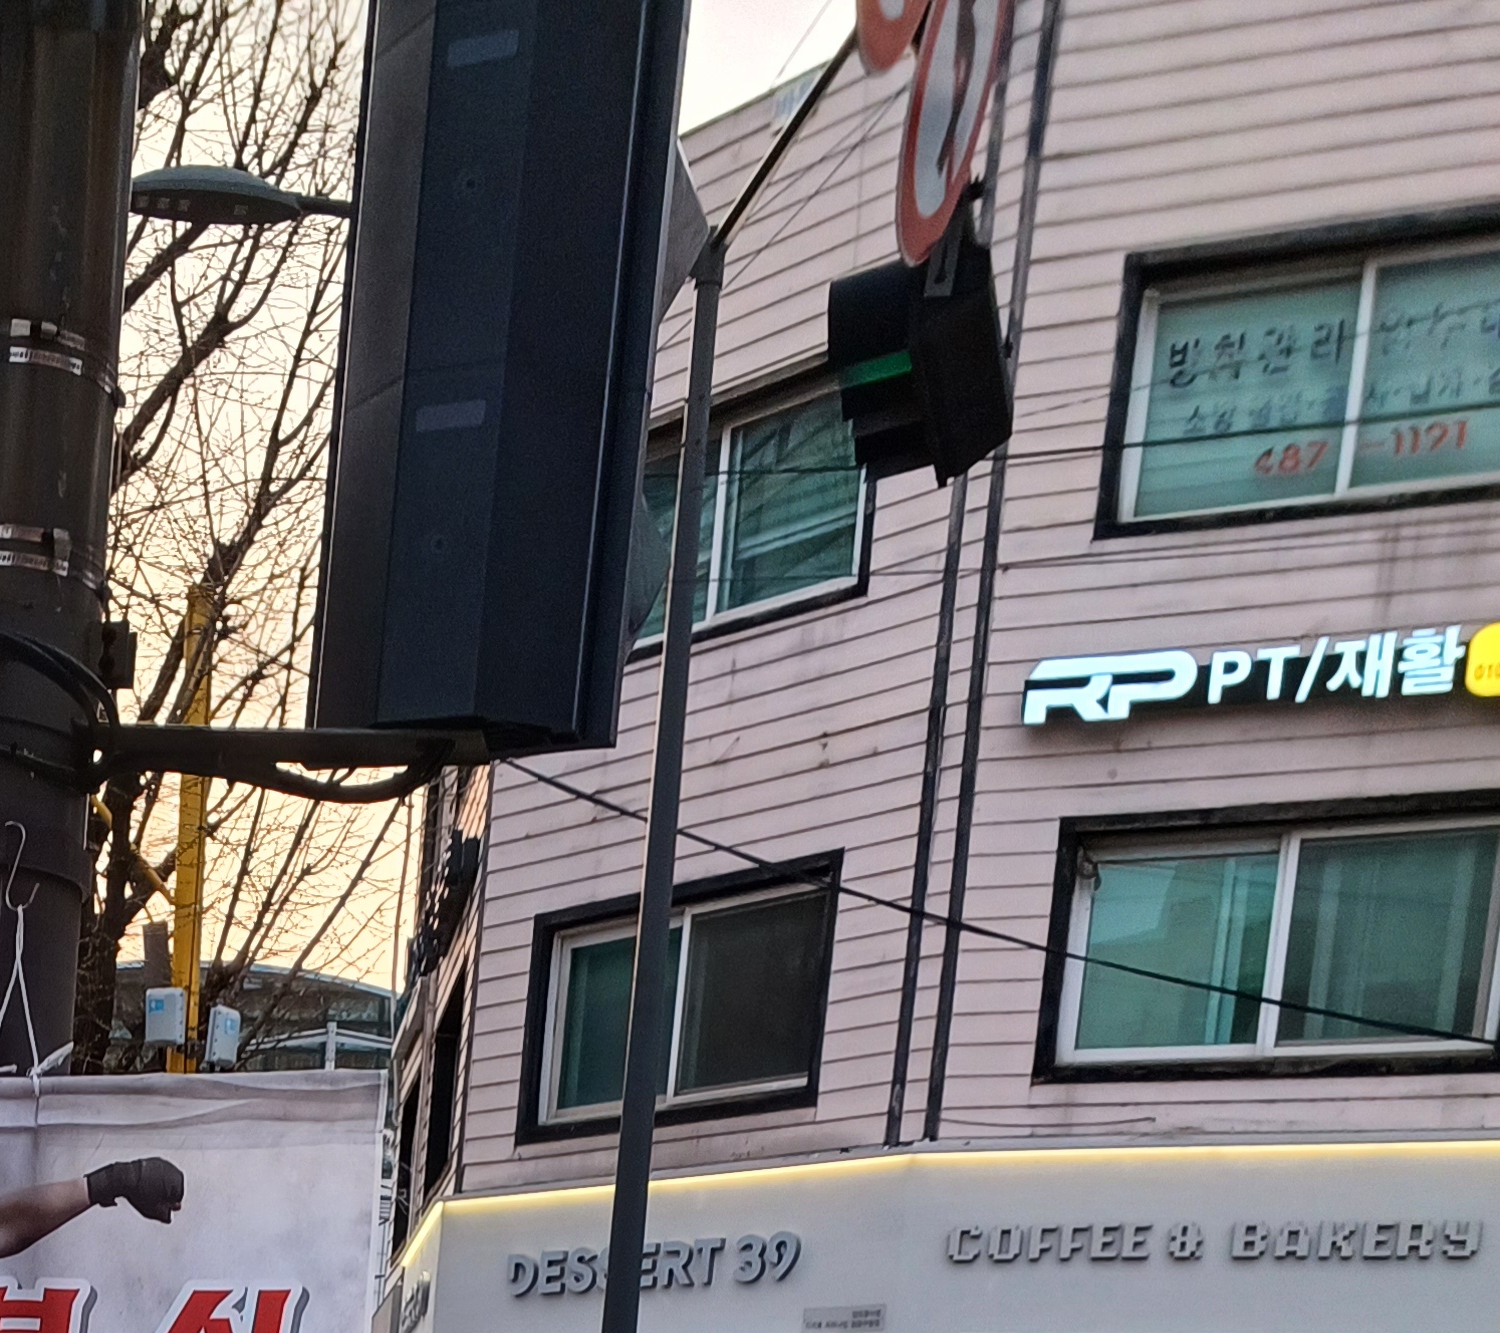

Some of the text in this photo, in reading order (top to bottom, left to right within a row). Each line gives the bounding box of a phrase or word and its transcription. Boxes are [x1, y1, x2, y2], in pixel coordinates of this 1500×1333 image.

[1207, 625, 1466, 704] PT/재활
[732, 1230, 803, 1286] 39
[946, 1222, 1155, 1263] COFFEE
[1230, 1219, 1485, 1262] BAKERY
